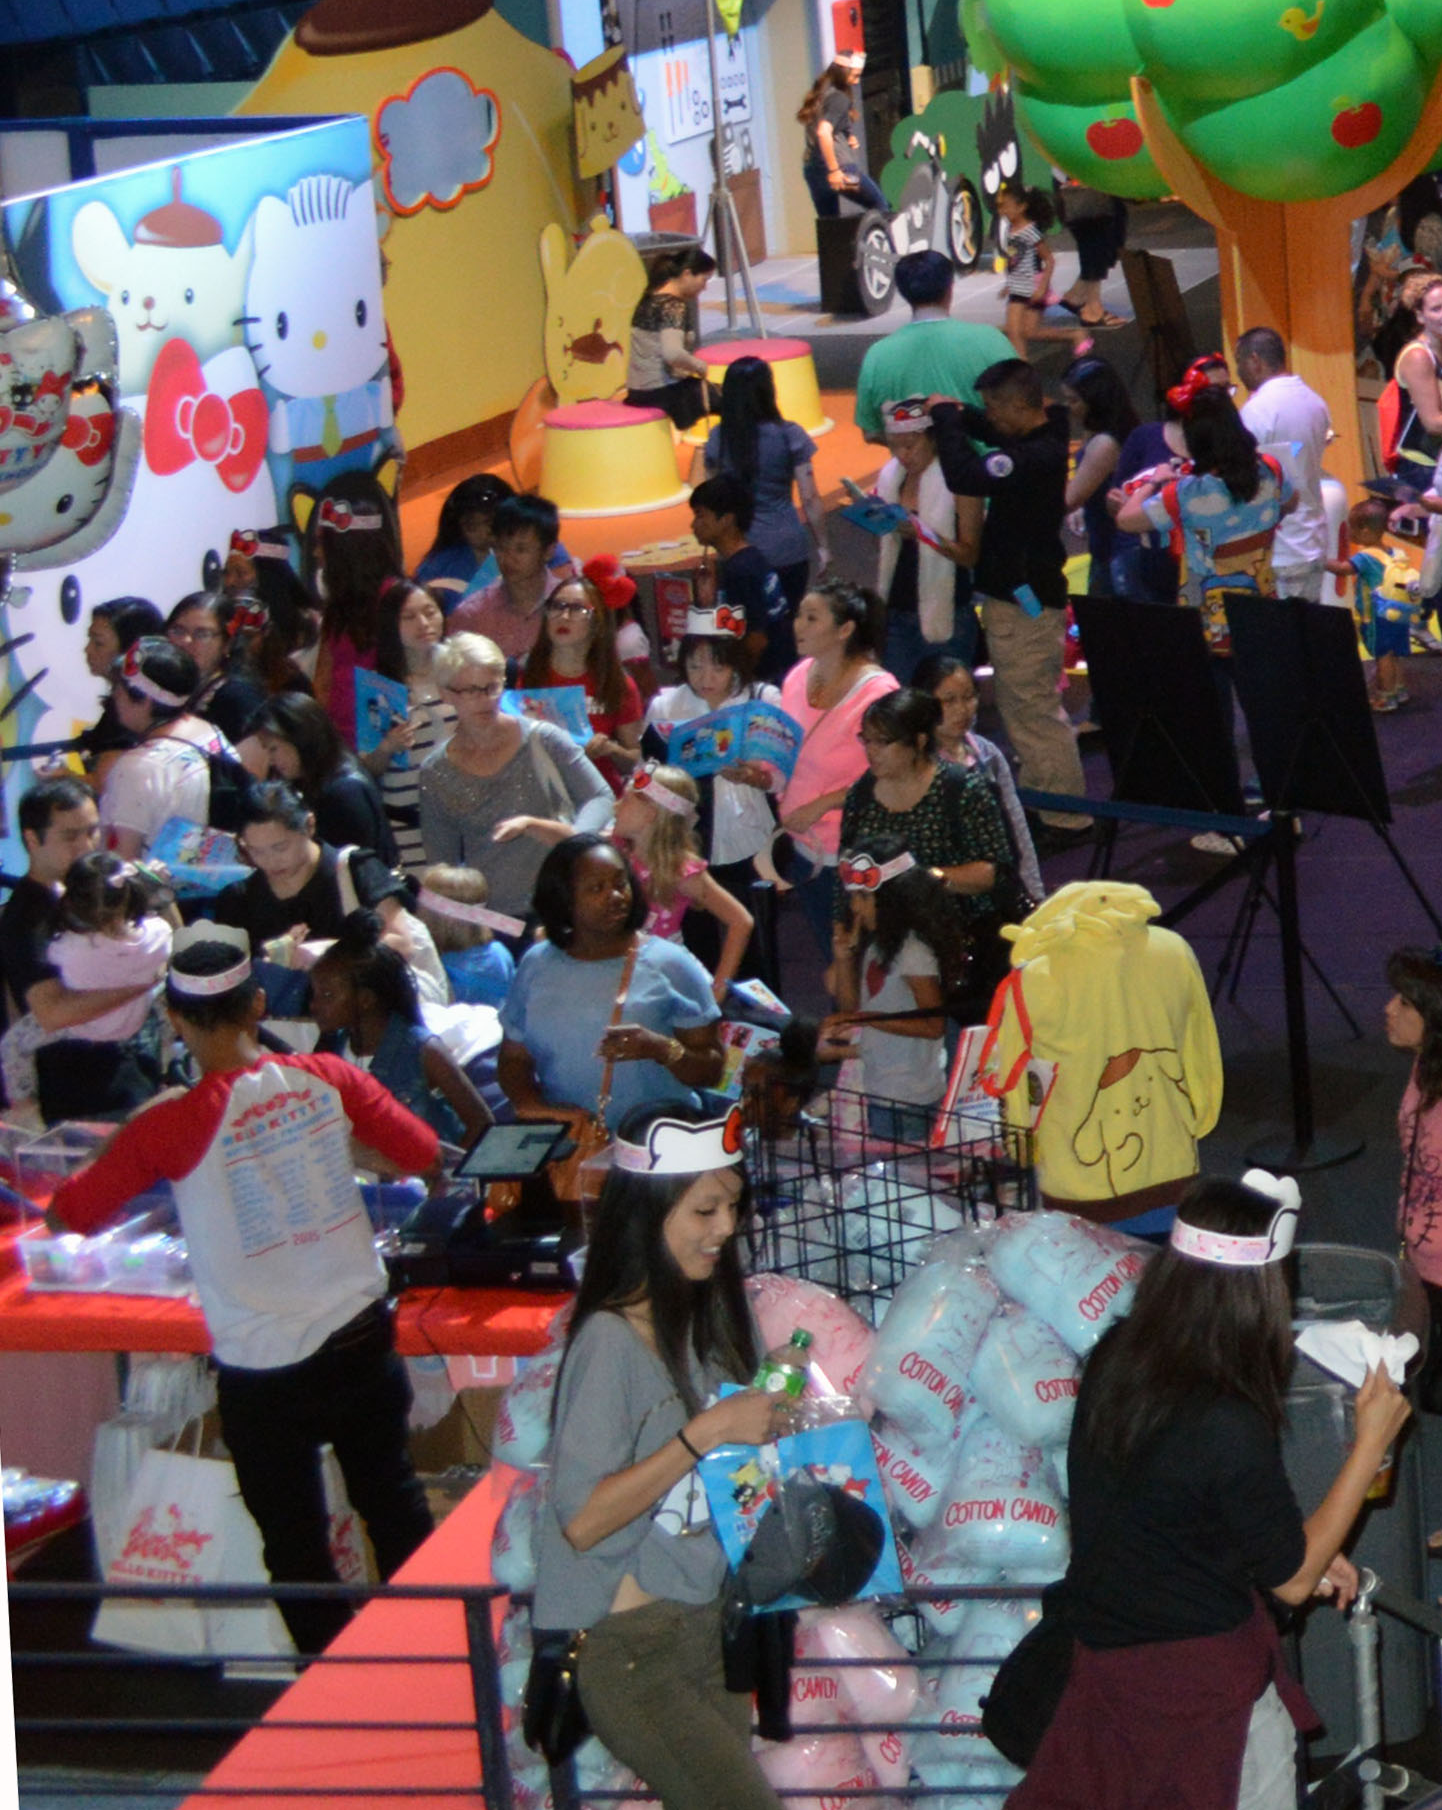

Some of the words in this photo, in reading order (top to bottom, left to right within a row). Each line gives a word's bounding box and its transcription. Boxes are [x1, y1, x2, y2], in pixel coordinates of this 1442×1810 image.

[1078, 1270, 1120, 1322] COTTON
[898, 1351, 949, 1397] COTTON
[889, 1459, 939, 1505] CANDY
[943, 1497, 1006, 1529] COTTON
[1010, 1496, 1060, 1529] CANDY
